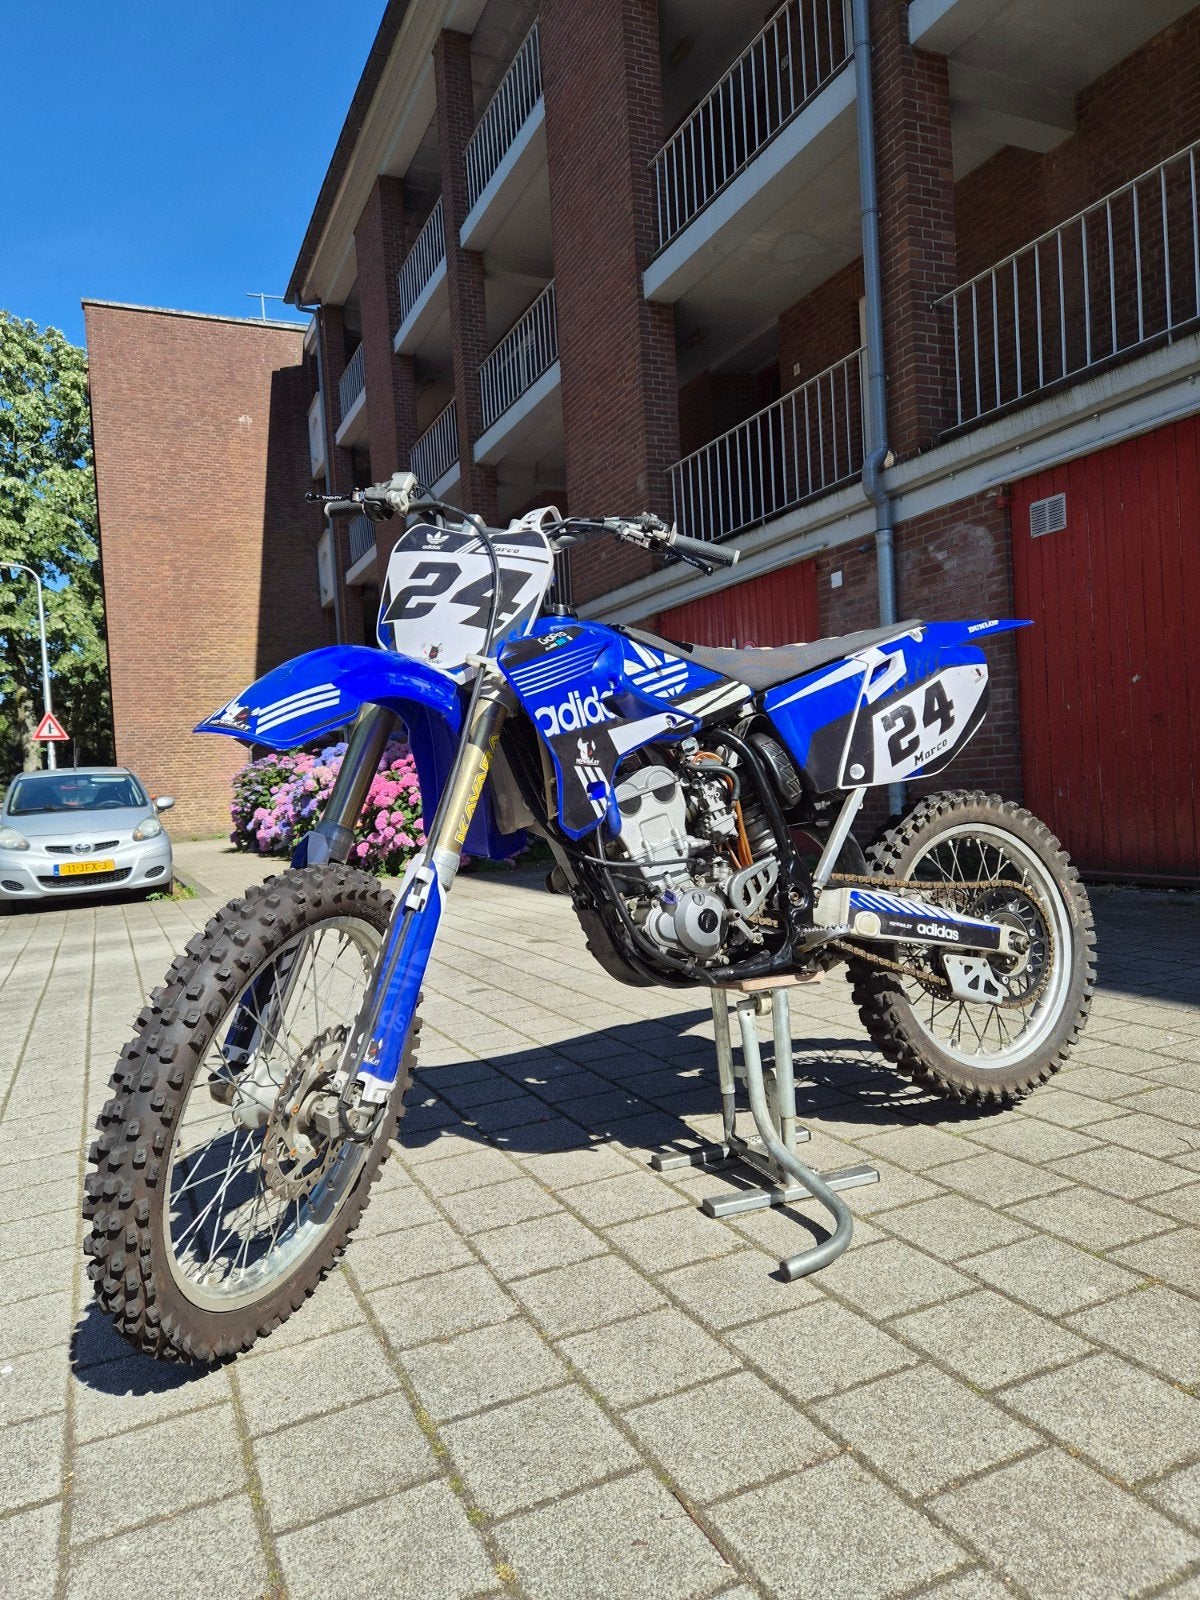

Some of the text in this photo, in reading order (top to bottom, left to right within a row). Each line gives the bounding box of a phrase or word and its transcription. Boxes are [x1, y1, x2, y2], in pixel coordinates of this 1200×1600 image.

[484, 544, 520, 554] arco
[383, 561, 533, 630] 24
[967, 619, 999, 634] DUNLOP
[537, 631, 567, 645] GoPro
[880, 679, 955, 768] 24
[913, 738, 948, 767] Marco
[916, 922, 960, 941] adidas
